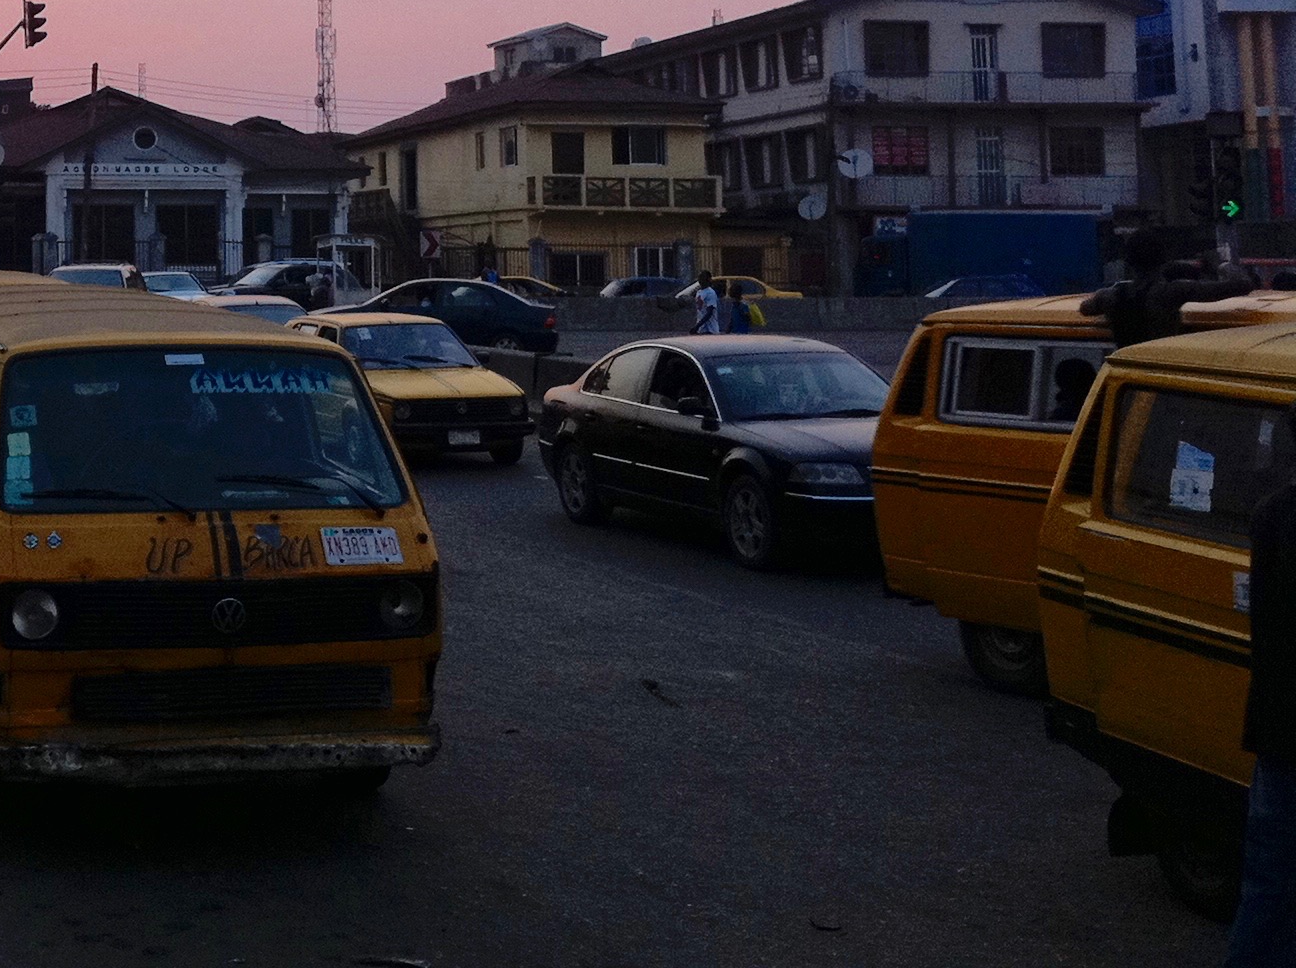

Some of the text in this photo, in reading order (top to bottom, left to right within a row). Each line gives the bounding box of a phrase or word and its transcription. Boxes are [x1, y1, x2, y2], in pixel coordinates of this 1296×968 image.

[63, 165, 218, 173] AGONMAGBE LODGE
[146, 534, 316, 573] UP BARCA
